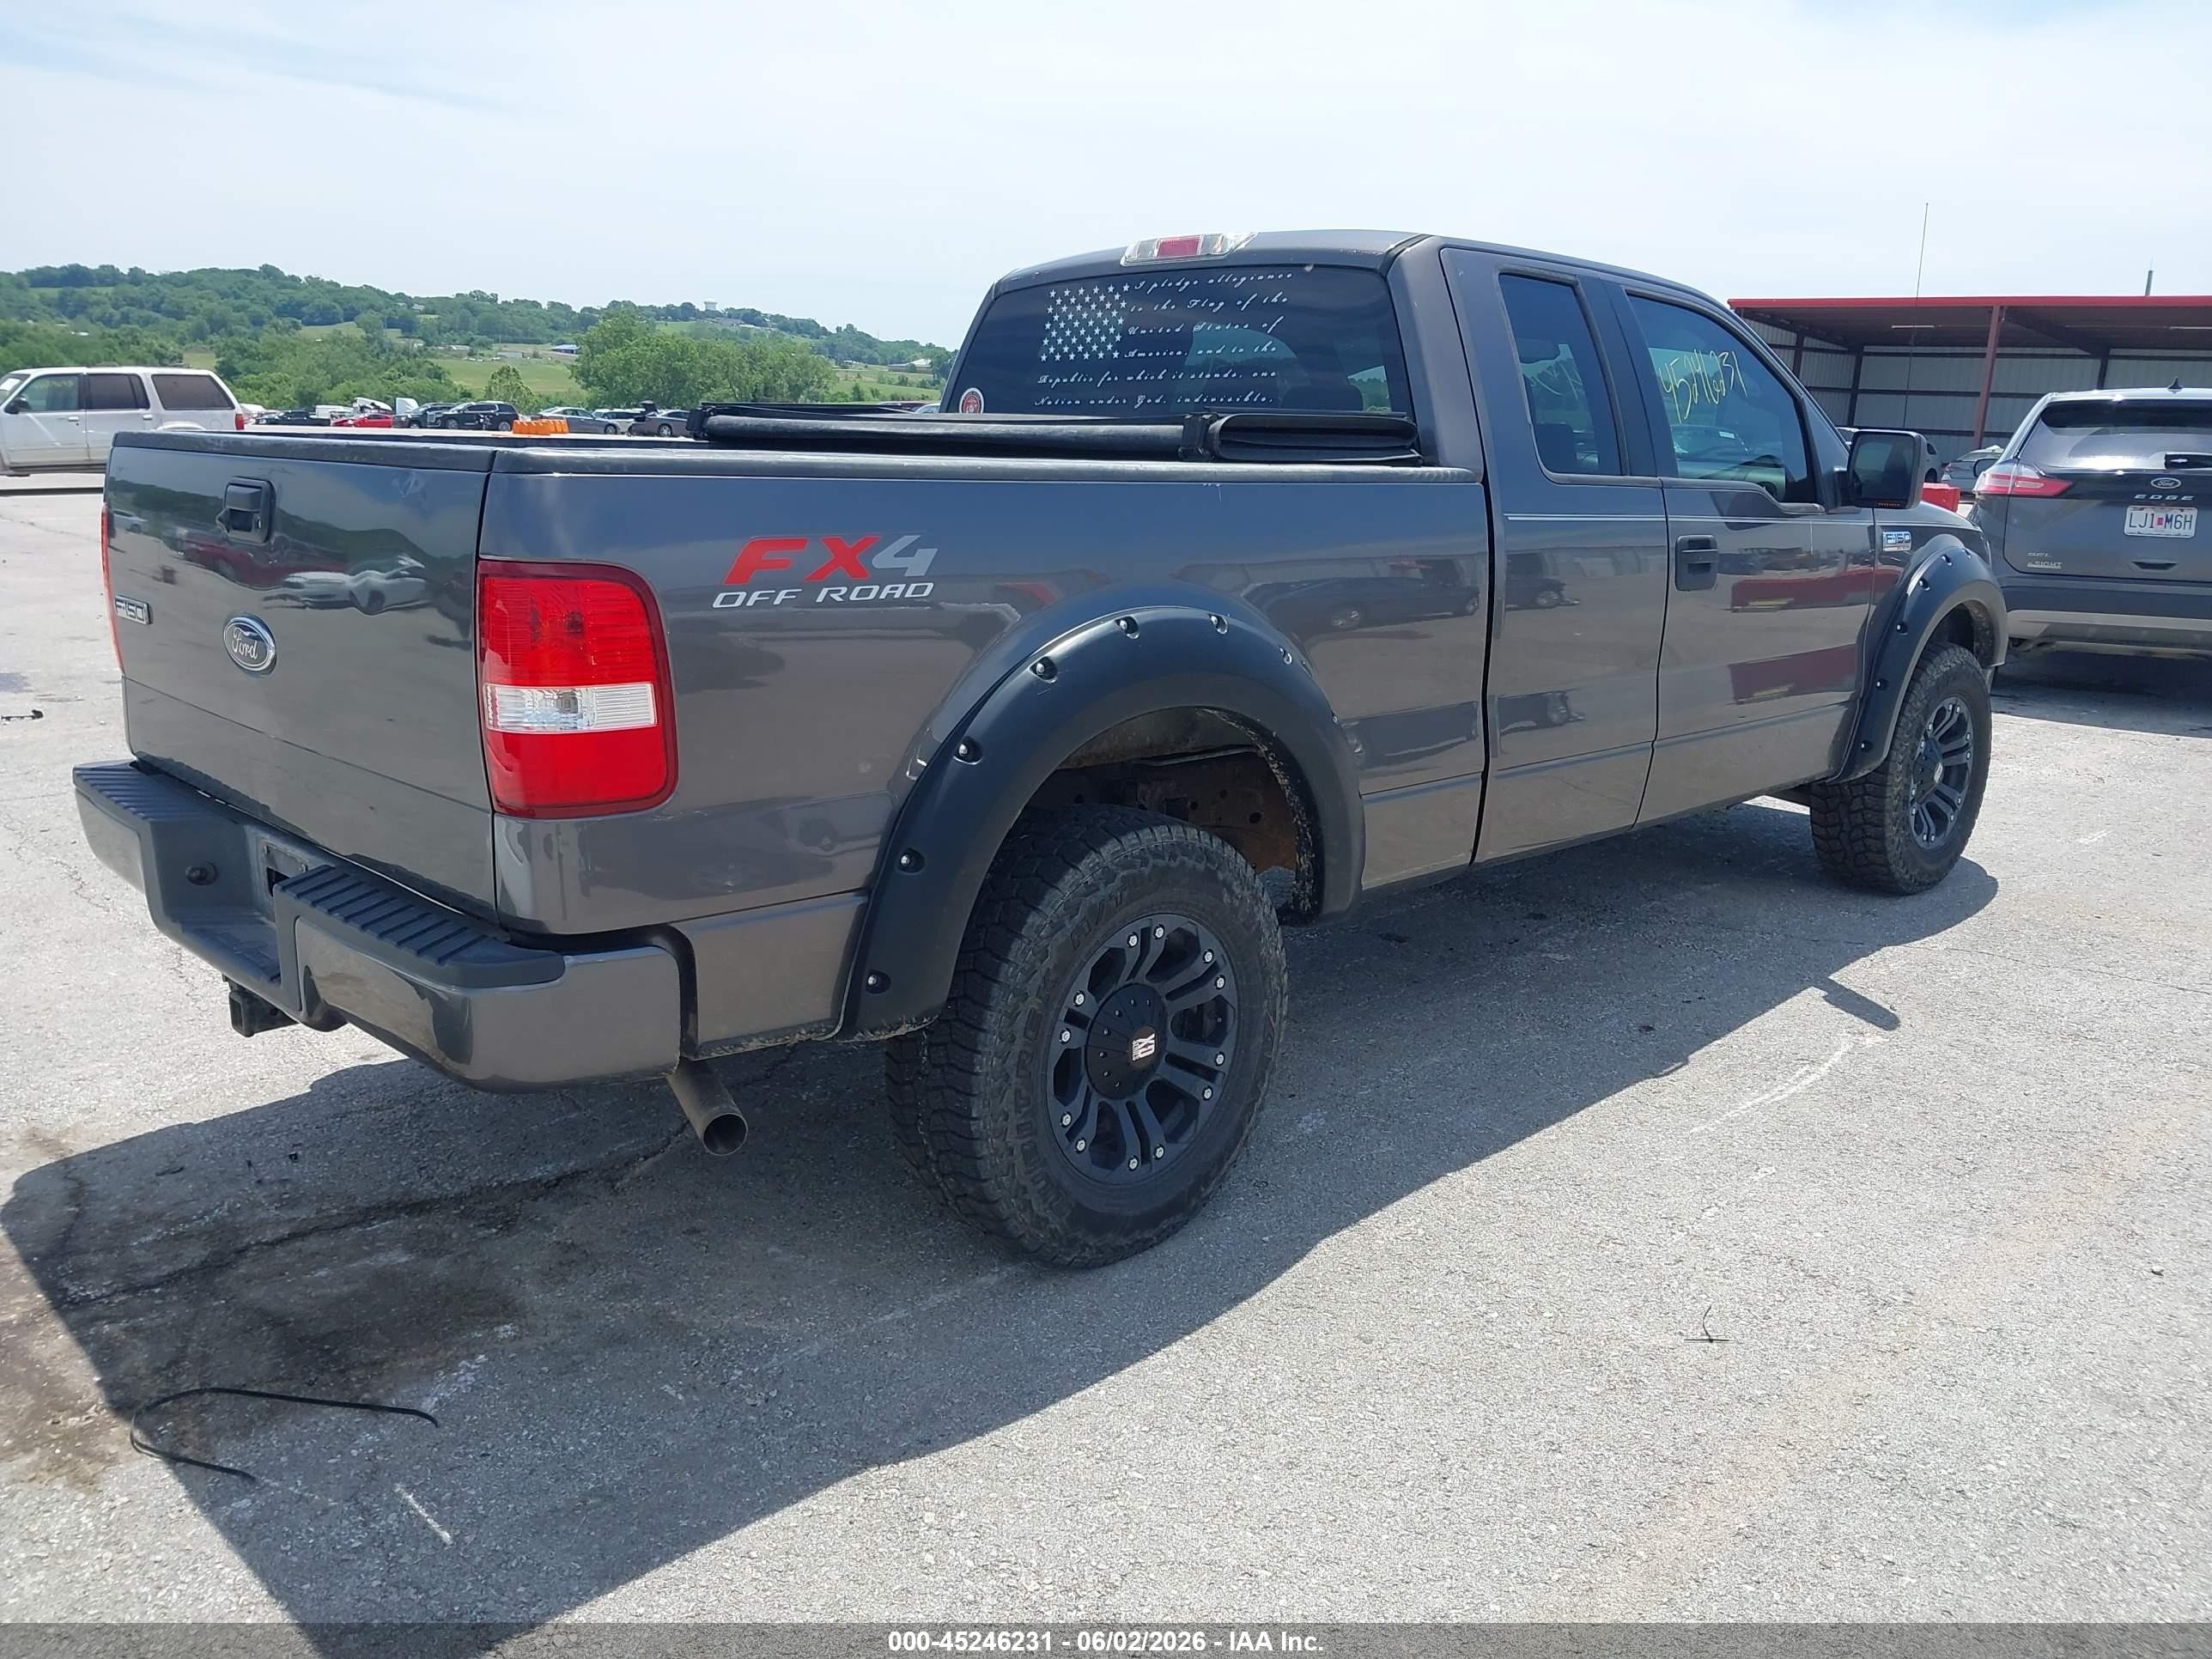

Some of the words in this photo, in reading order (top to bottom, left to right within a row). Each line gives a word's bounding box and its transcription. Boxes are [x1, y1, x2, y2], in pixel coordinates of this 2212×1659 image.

[1146, 277, 1199, 295] pledge
[1208, 273, 1292, 288] allegiance
[1130, 304, 1143, 313] to
[1153, 299, 1176, 311] the
[1187, 299, 1224, 313] Flag
[1236, 293, 1258, 311] of
[1262, 291, 1288, 303] the
[1127, 323, 1184, 336] United
[1193, 322, 1249, 332] States
[1261, 315, 1285, 334] of
[1197, 344, 1225, 355] and
[1254, 340, 1277, 352] the
[1037, 372, 1093, 388] Republic
[1097, 371, 1118, 387] for
[1127, 368, 1167, 380] which
[1172, 371, 1184, 380] it
[1035, 396, 1080, 405] Nation
[1089, 395, 1127, 404] under
[723, 535, 939, 585] FX4
[712, 588, 803, 608] OFF
[816, 582, 934, 603] ROAD
[232, 627, 258, 660] Ford
